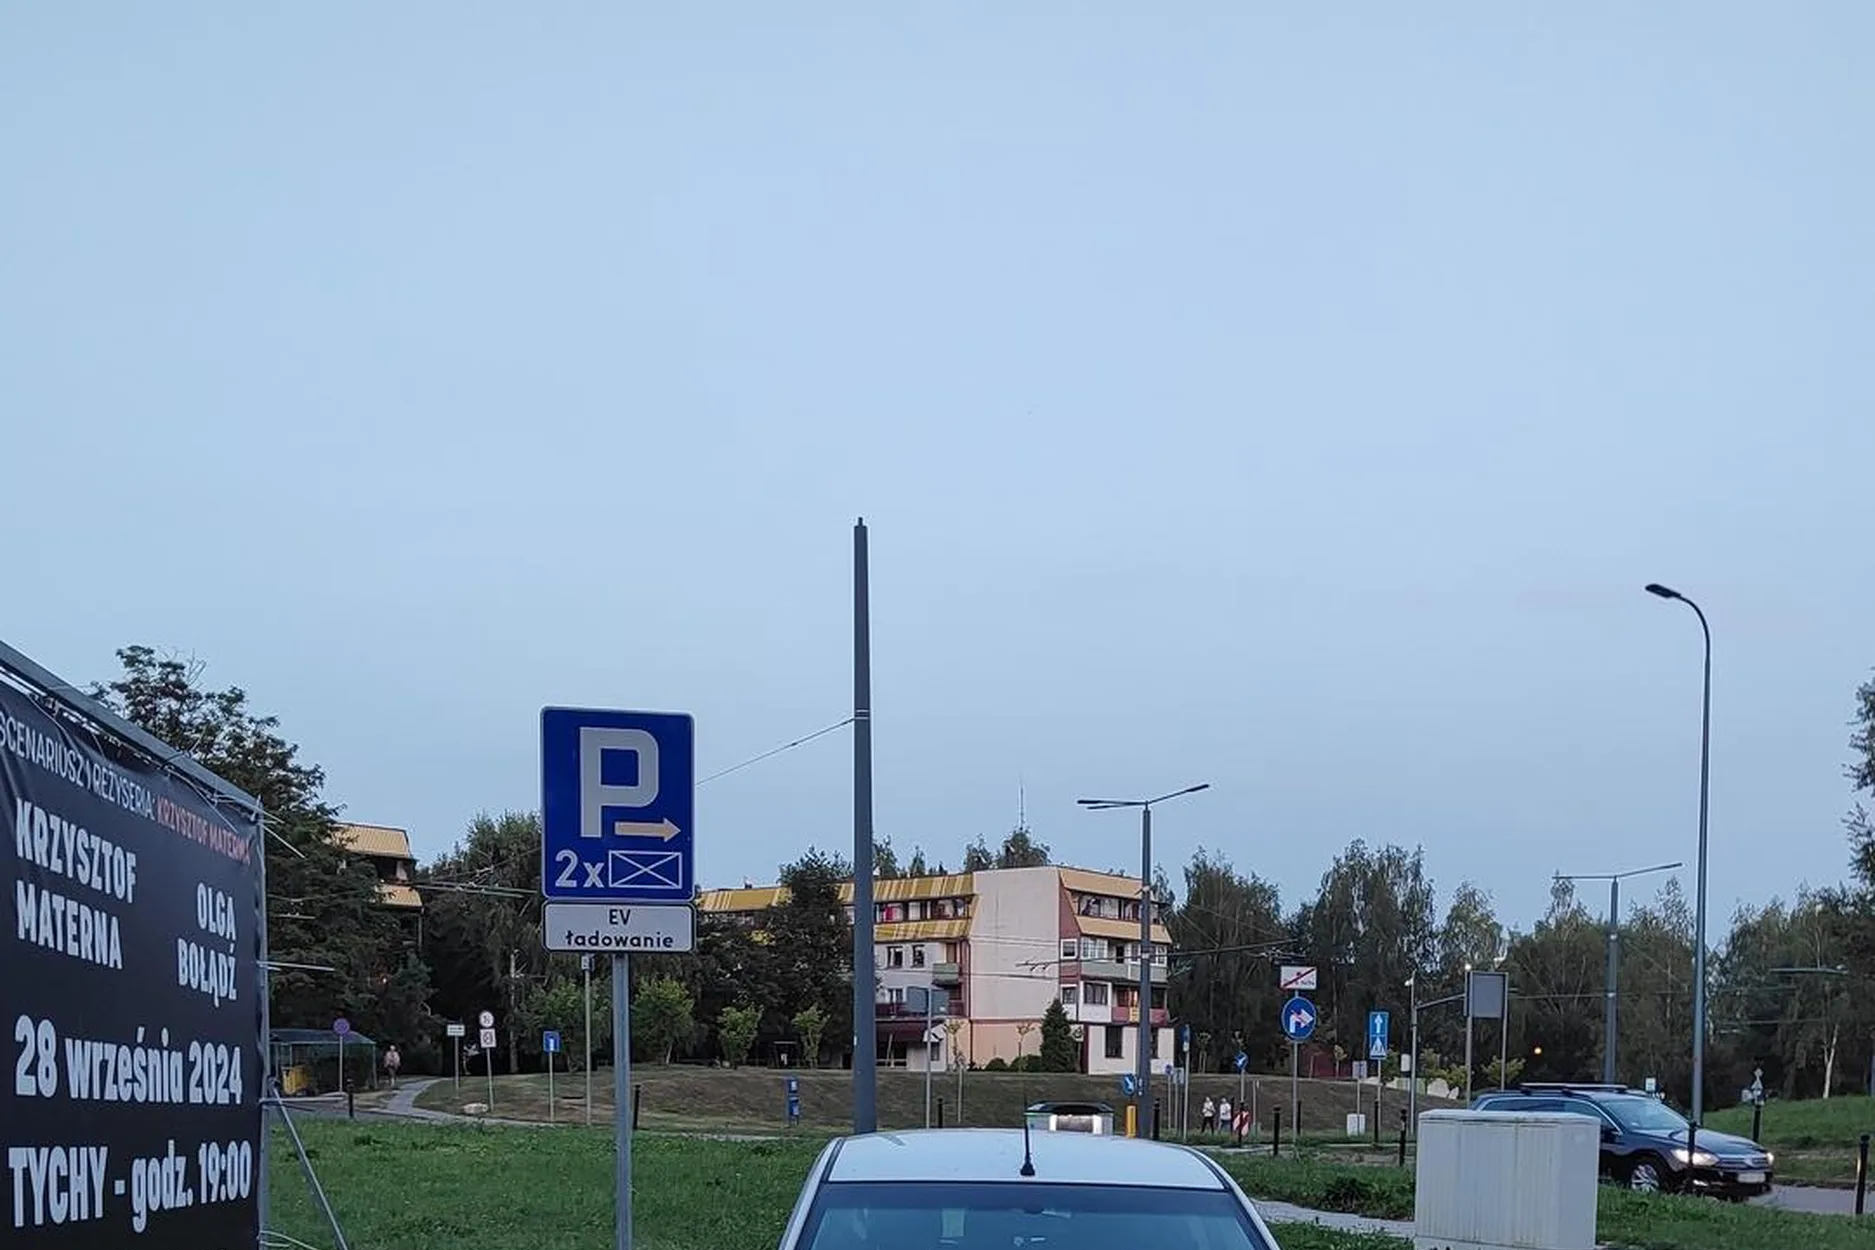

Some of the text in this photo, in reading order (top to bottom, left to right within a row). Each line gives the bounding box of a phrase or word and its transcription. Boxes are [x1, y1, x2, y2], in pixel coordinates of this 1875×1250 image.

[0, 711, 84, 787] SCENARIUSZ
[579, 726, 659, 838] P
[16, 797, 137, 904] KRZYSZTOF
[16, 879, 123, 970] MATERNA
[197, 882, 236, 940] OLGA
[565, 930, 674, 948] ładowanie
[608, 908, 632, 925] EV
[178, 937, 237, 1008] BOŁĄDŹ
[15, 1014, 243, 1105] 28 września 2024
[8, 1145, 108, 1228] TYCHY
[131, 1139, 194, 1234] godz.
[199, 1140, 252, 1204] 19:00
